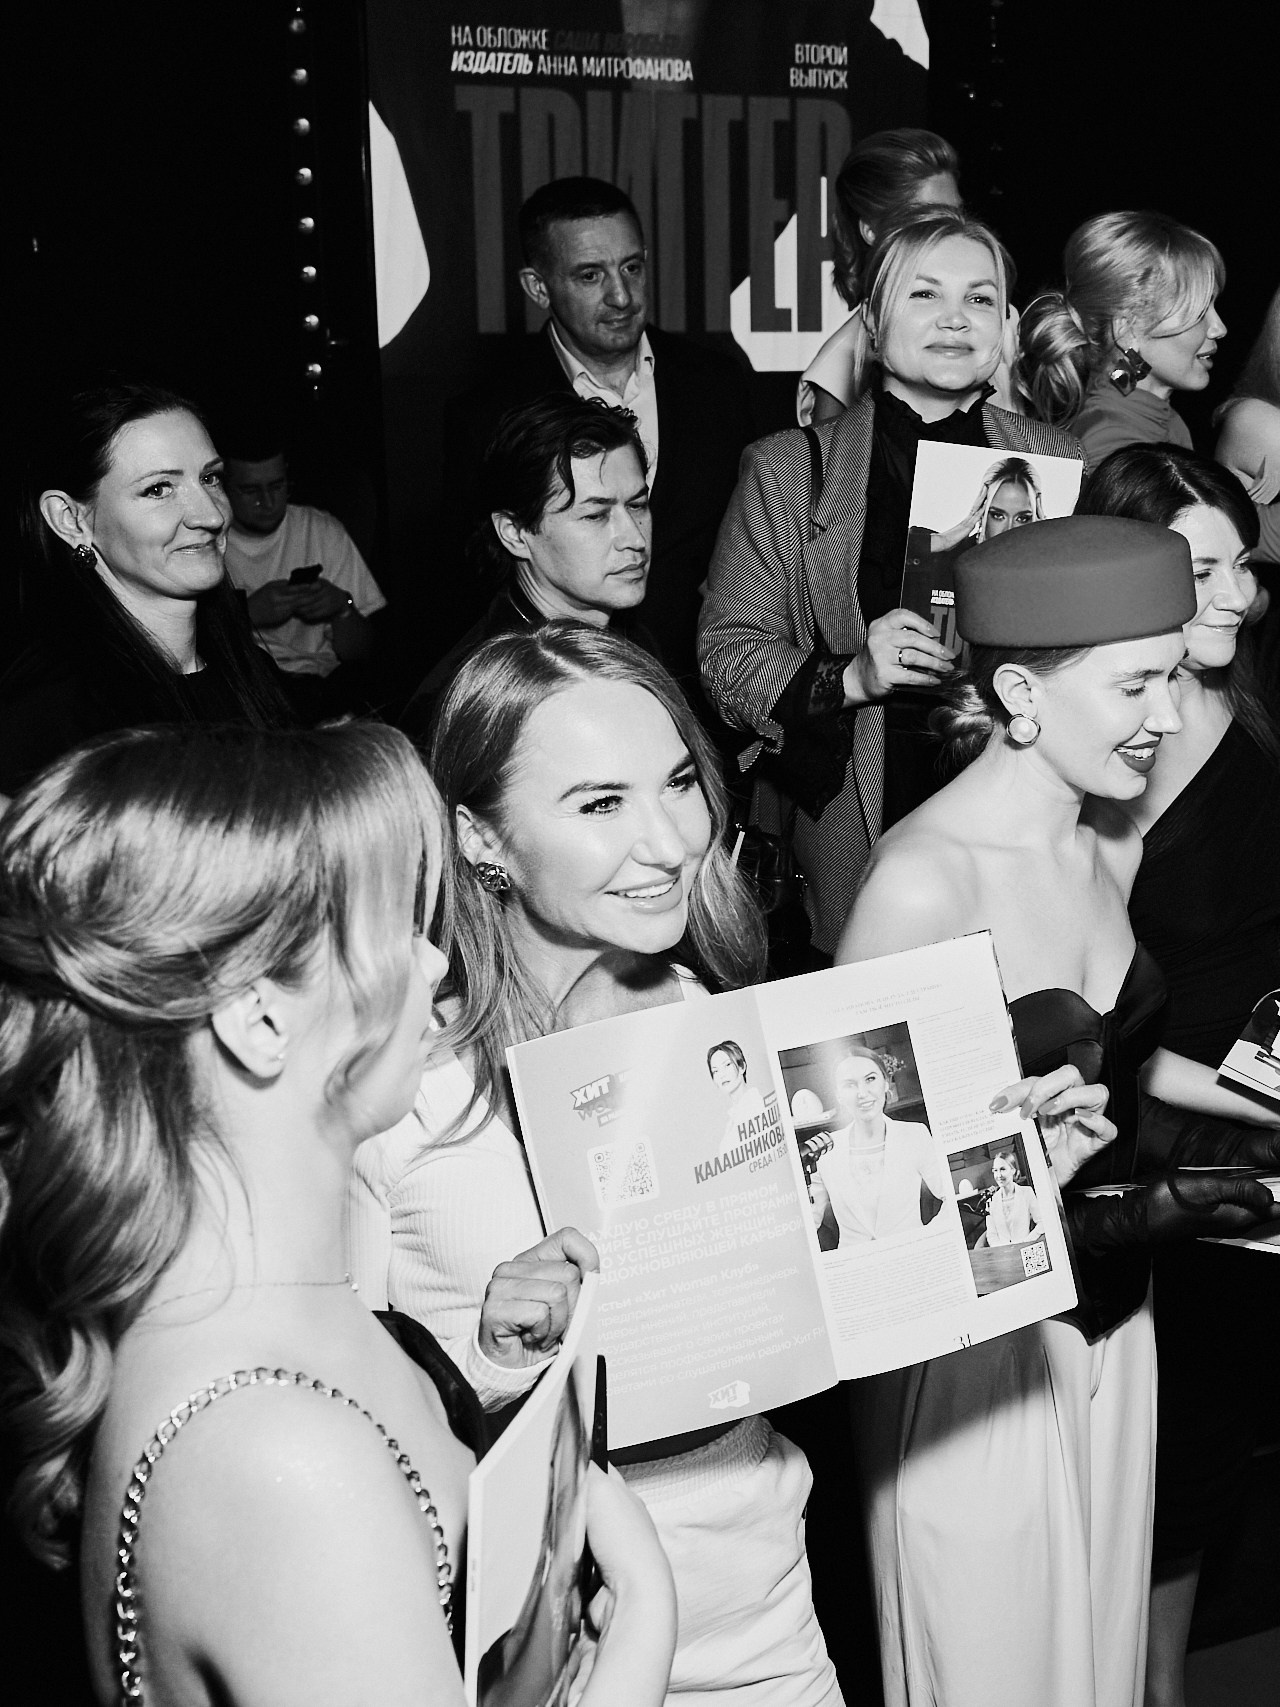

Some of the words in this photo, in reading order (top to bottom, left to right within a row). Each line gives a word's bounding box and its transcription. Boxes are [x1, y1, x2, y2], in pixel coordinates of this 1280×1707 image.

[451, 25, 473, 48] НА
[475, 26, 549, 51] ОБЛОЖКЕ
[451, 51, 533, 76] ИЗДАТЕЛЬ
[536, 54, 579, 78] АННА
[582, 56, 694, 82] МИТРОФАНОВА
[795, 42, 849, 66] ВТОРОЙ
[790, 67, 849, 90] ВЫПУСК
[571, 1075, 612, 1108] ХИТ
[585, 1218, 649, 1242] АЖДУЮ
[653, 1203, 702, 1227] СРЕДУ
[706, 1200, 717, 1214] В
[719, 1182, 779, 1210] ПРЯМОМ
[616, 1231, 706, 1267] УСПЕШНЫХ
[710, 1212, 777, 1240] ЖЕНЩИН
[635, 1212, 721, 1245] СЛУШАЙТЕ
[669, 1273, 718, 1295] Woman
